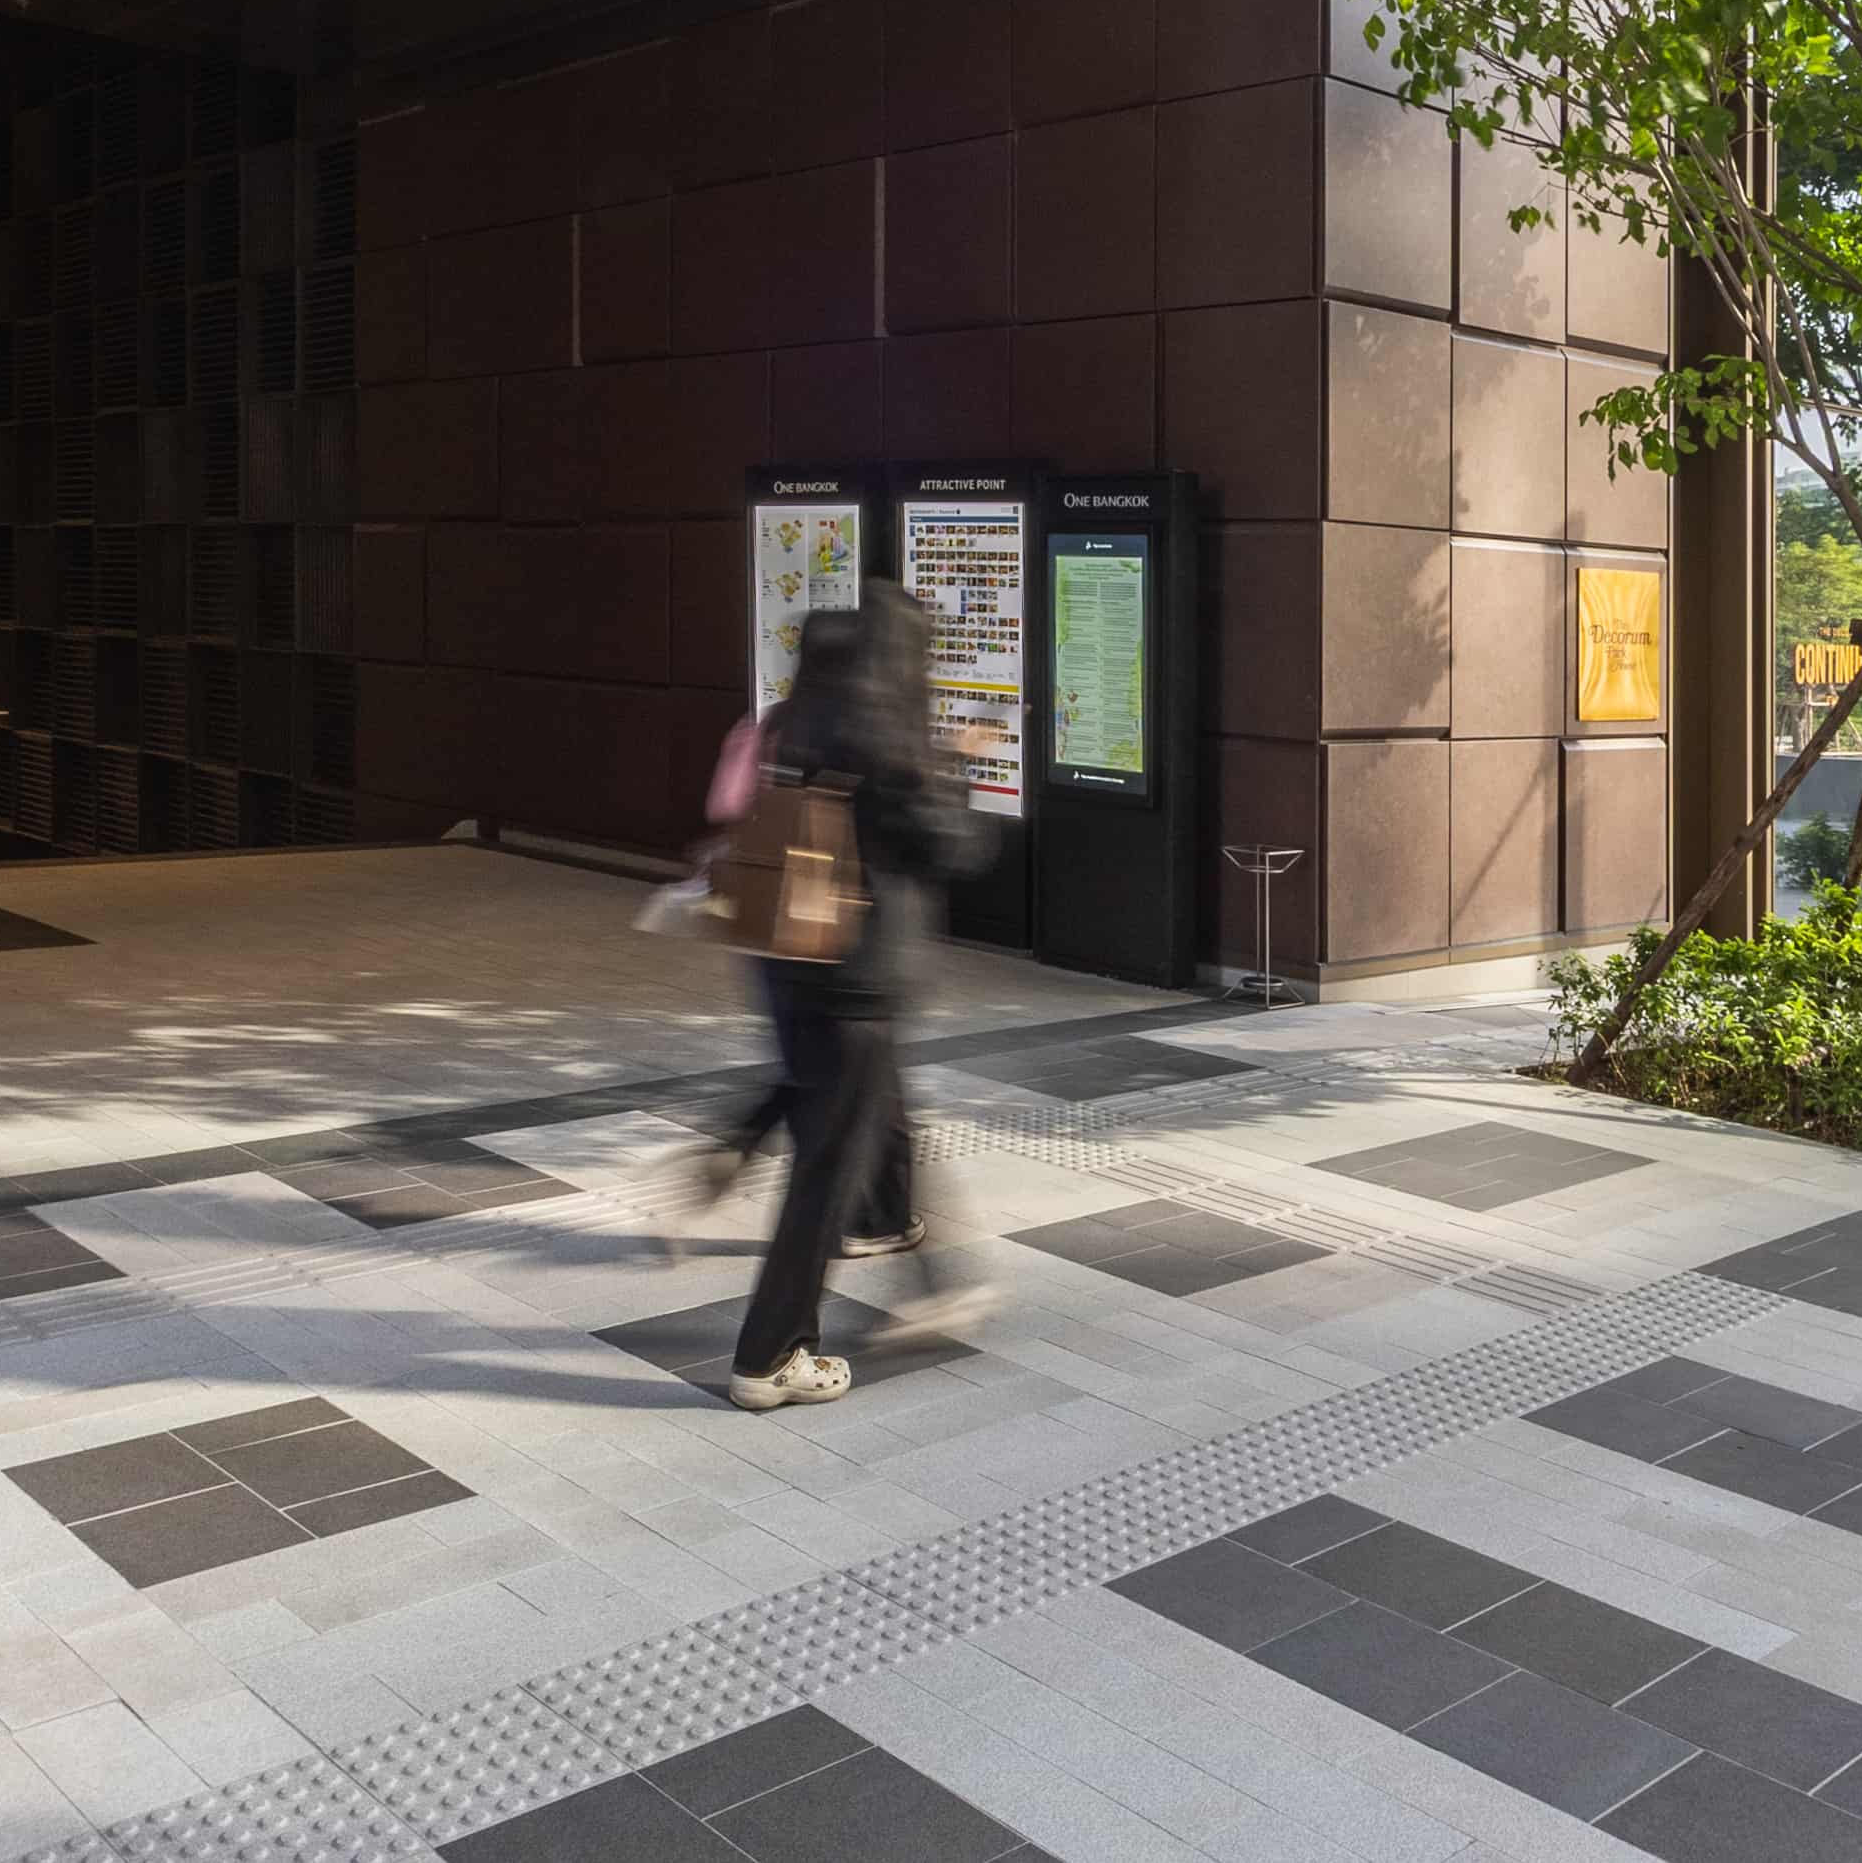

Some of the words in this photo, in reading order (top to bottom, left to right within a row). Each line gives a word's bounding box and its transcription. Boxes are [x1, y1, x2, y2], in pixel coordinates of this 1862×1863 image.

[773, 480, 794, 495] ONE
[795, 482, 839, 494] BANGKOK
[920, 479, 975, 491] ATTRACTIVE
[976, 478, 1007, 491] POINT
[1064, 491, 1091, 508] ONE
[1092, 495, 1150, 508] BANGKOK
[1587, 624, 1653, 647] Decorum
